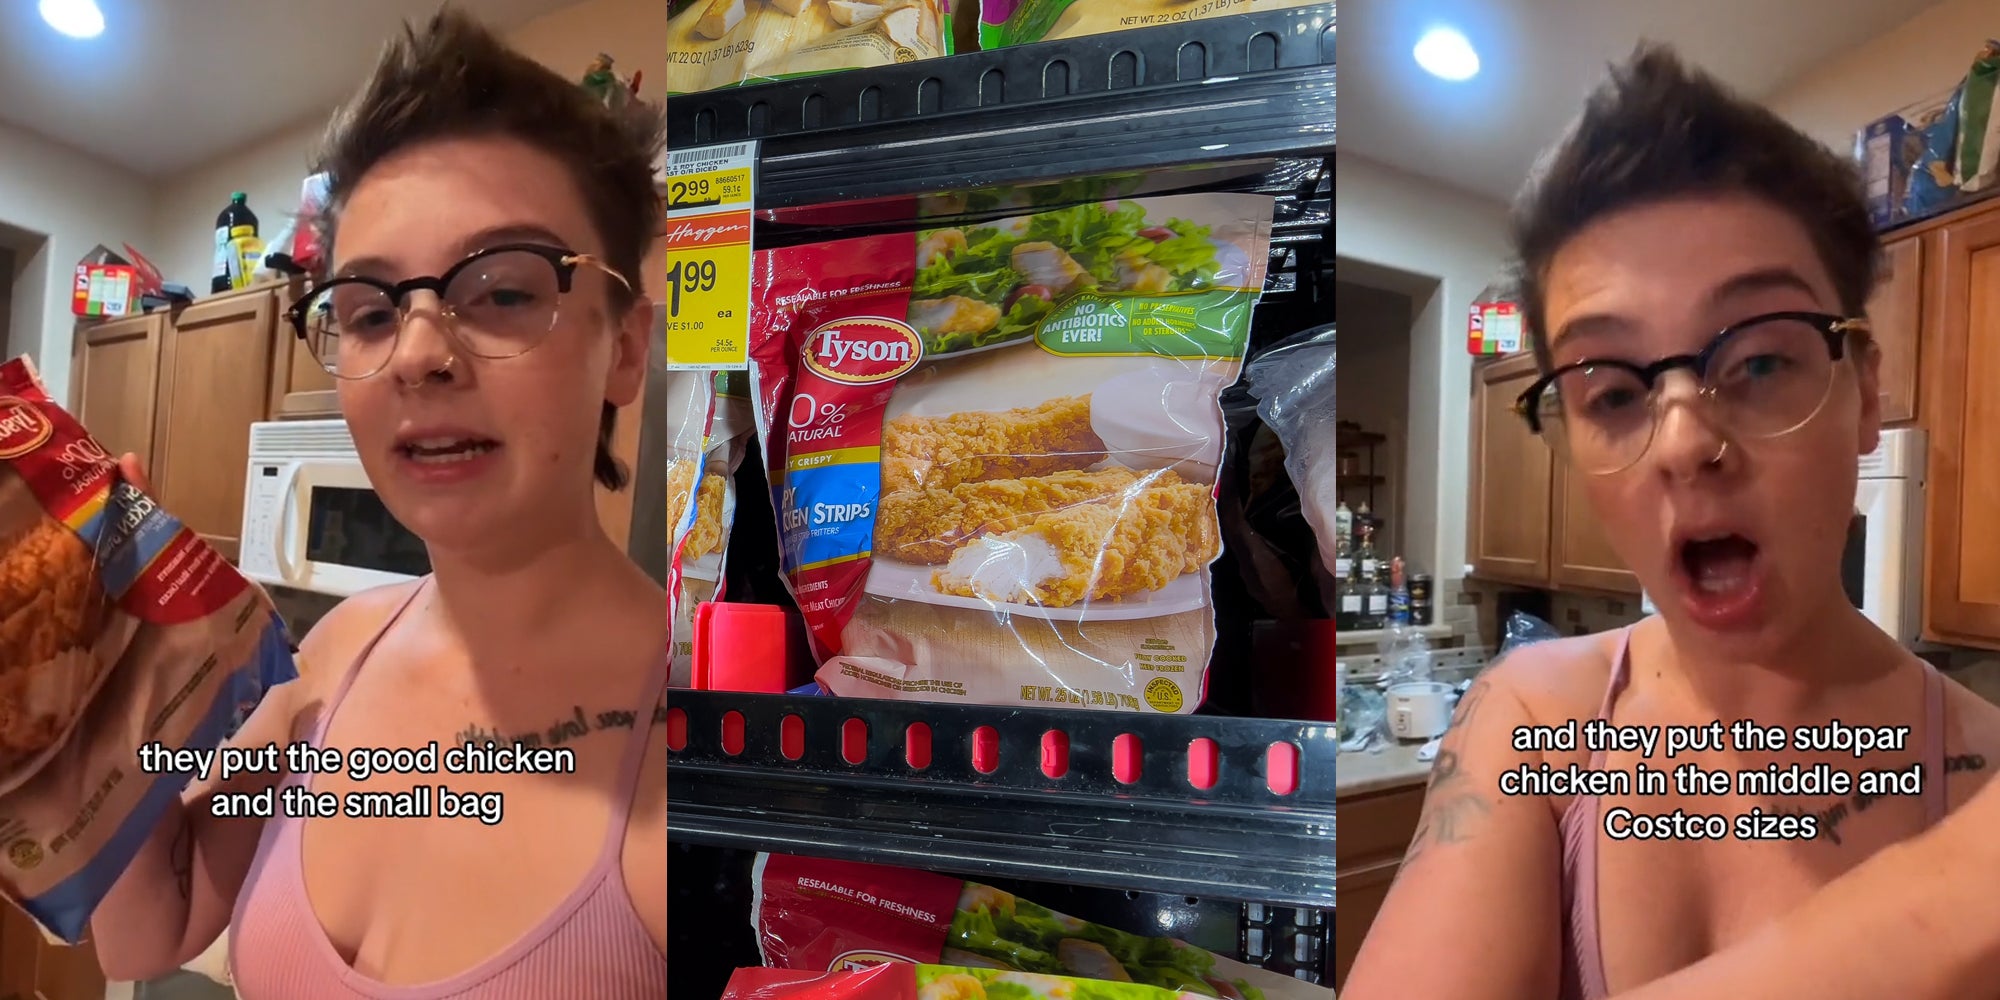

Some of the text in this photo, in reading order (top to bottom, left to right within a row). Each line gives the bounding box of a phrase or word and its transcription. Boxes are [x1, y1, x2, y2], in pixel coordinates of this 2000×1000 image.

[1119, 16, 1138, 26] NET
[1140, 15, 1155, 25] WT.
[1157, 13, 1170, 23] 22
[1172, 11, 1187, 21] OZ
[1189, 3, 1212, 21] (1.37
[679, 52, 689, 63] 22
[690, 52, 702, 63] OZ
[703, 49, 722, 66] (1.37
[723, 45, 734, 59] LB)
[735, 40, 755, 53] 623g
[695, 165, 718, 173] DICED
[696, 159, 729, 168] CHICKEN
[667, 222, 748, 243] Haggen
[829, 288, 848, 298] FOR
[717, 310, 732, 318] ea
[1074, 303, 1096, 316] NO
[667, 322, 704, 331] VE $1.00
[1042, 313, 1127, 335] ANTIBIOTICS
[1132, 318, 1142, 326] NO
[1062, 328, 1102, 343] EVER!
[816, 330, 911, 367] Tyson
[788, 393, 846, 428] 0%
[789, 426, 843, 443] ATURAL
[798, 455, 832, 466] CRISPY
[782, 487, 796, 510] PY
[814, 503, 870, 525] STRIPS
[811, 527, 840, 537] FRITTERS
[810, 600, 825, 612] MEAT
[1020, 685, 1038, 700] NET
[1038, 686, 1053, 701] WT.
[1055, 687, 1067, 702] 25
[1147, 679, 1179, 695] INSPECTED
[1157, 692, 1171, 700] U.S.
[798, 877, 936, 924] RESEALABLE FOR FRESHNESS
